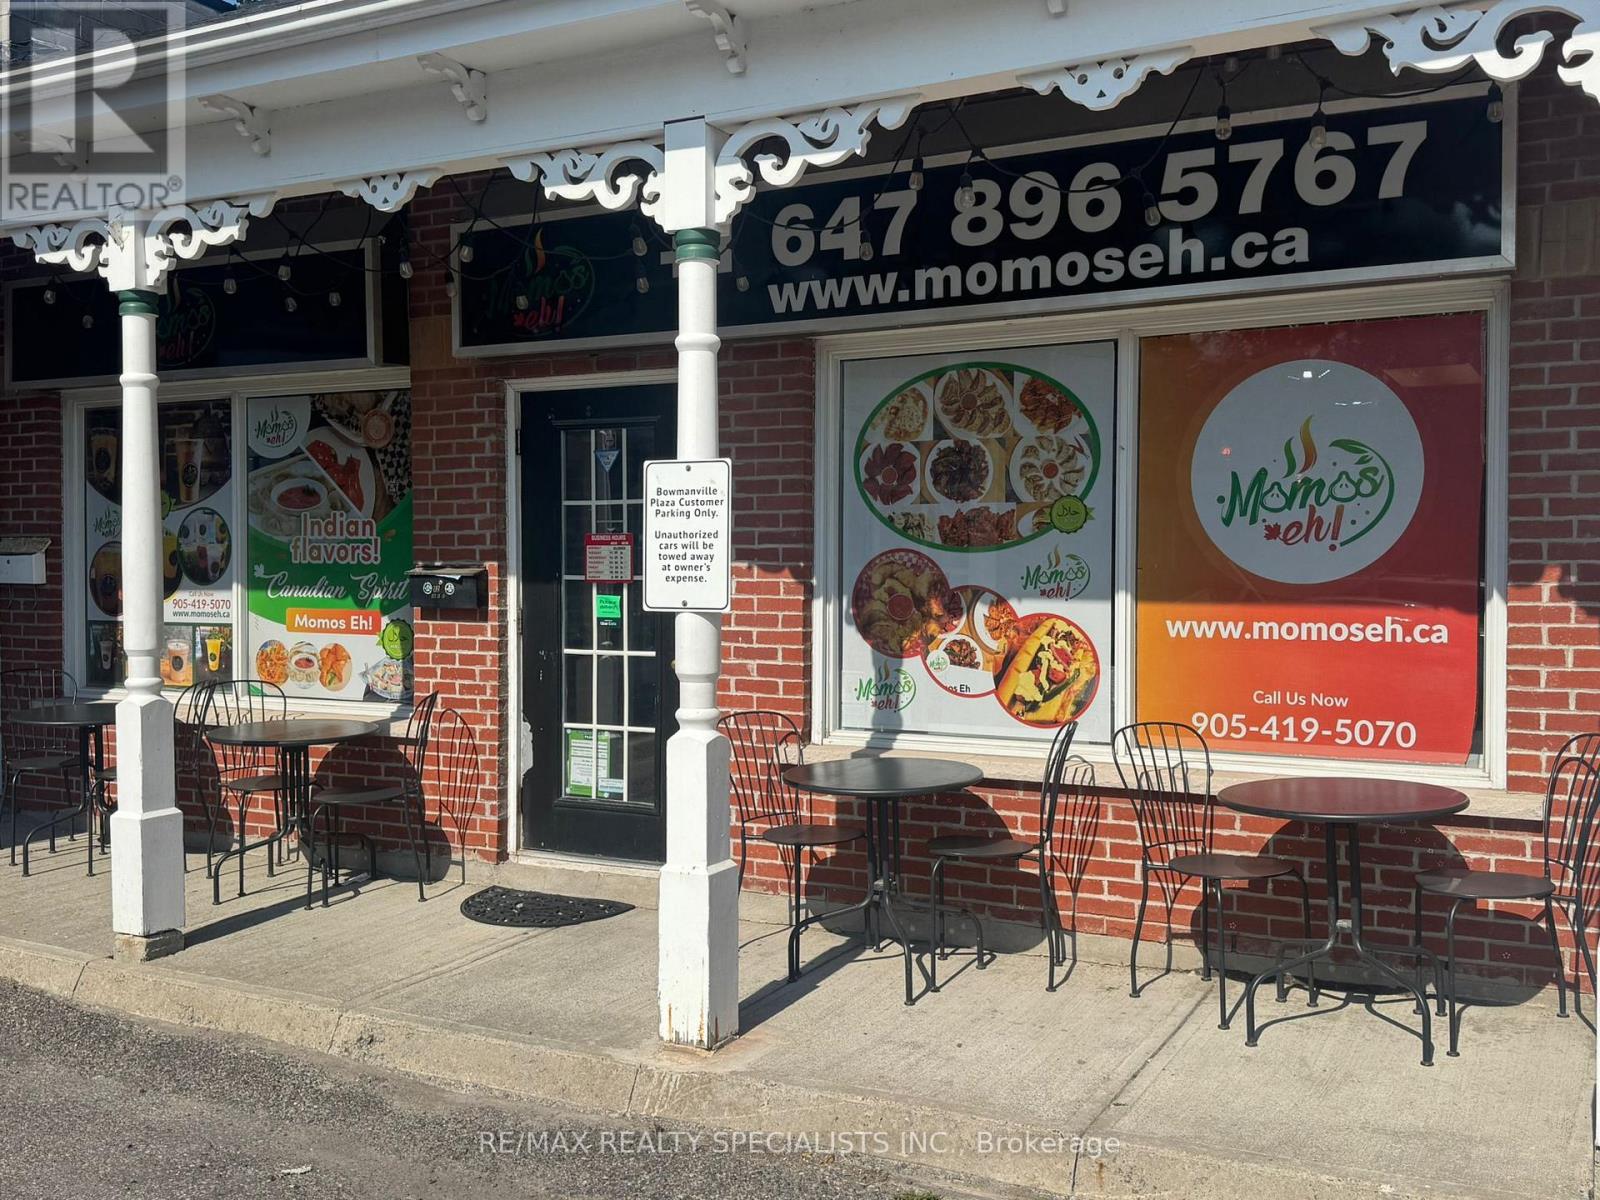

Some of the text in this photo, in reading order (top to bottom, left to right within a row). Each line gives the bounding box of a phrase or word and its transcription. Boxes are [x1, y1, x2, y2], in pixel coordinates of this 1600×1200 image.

[770, 189, 918, 267] 647
[951, 162, 1122, 248] 896
[1158, 120, 1428, 222] 5767
[768, 224, 1310, 314] www.momoseh.ca
[656, 487, 718, 496] Bowmanville
[1221, 465, 1384, 528] Momos
[650, 498, 724, 507] Plaza Customer
[655, 508, 719, 519] Parking Only.
[301, 512, 376, 538] Indian
[1281, 503, 1344, 552] eh!
[654, 530, 719, 540] Unauthorized
[290, 536, 381, 564] flavors!
[659, 540, 715, 550] cars will be
[658, 552, 715, 563] towed away
[661, 562, 711, 572] at owner's
[665, 574, 708, 584] expense.
[1022, 564, 1088, 592] Momos
[264, 571, 346, 599] Canadian
[350, 571, 409, 608] Spirit
[1045, 580, 1072, 602] eh!
[172, 598, 232, 610] 905-419-5070
[172, 610, 231, 618] www.momoseh.ca
[294, 614, 373, 630] Momos Eh!
[1165, 615, 1449, 644] www.momoseh.ca
[856, 677, 914, 704] Momos
[960, 684, 971, 693] Eh
[1253, 689, 1349, 708] Call Us Now
[1191, 711, 1417, 748] 905-419-5070
